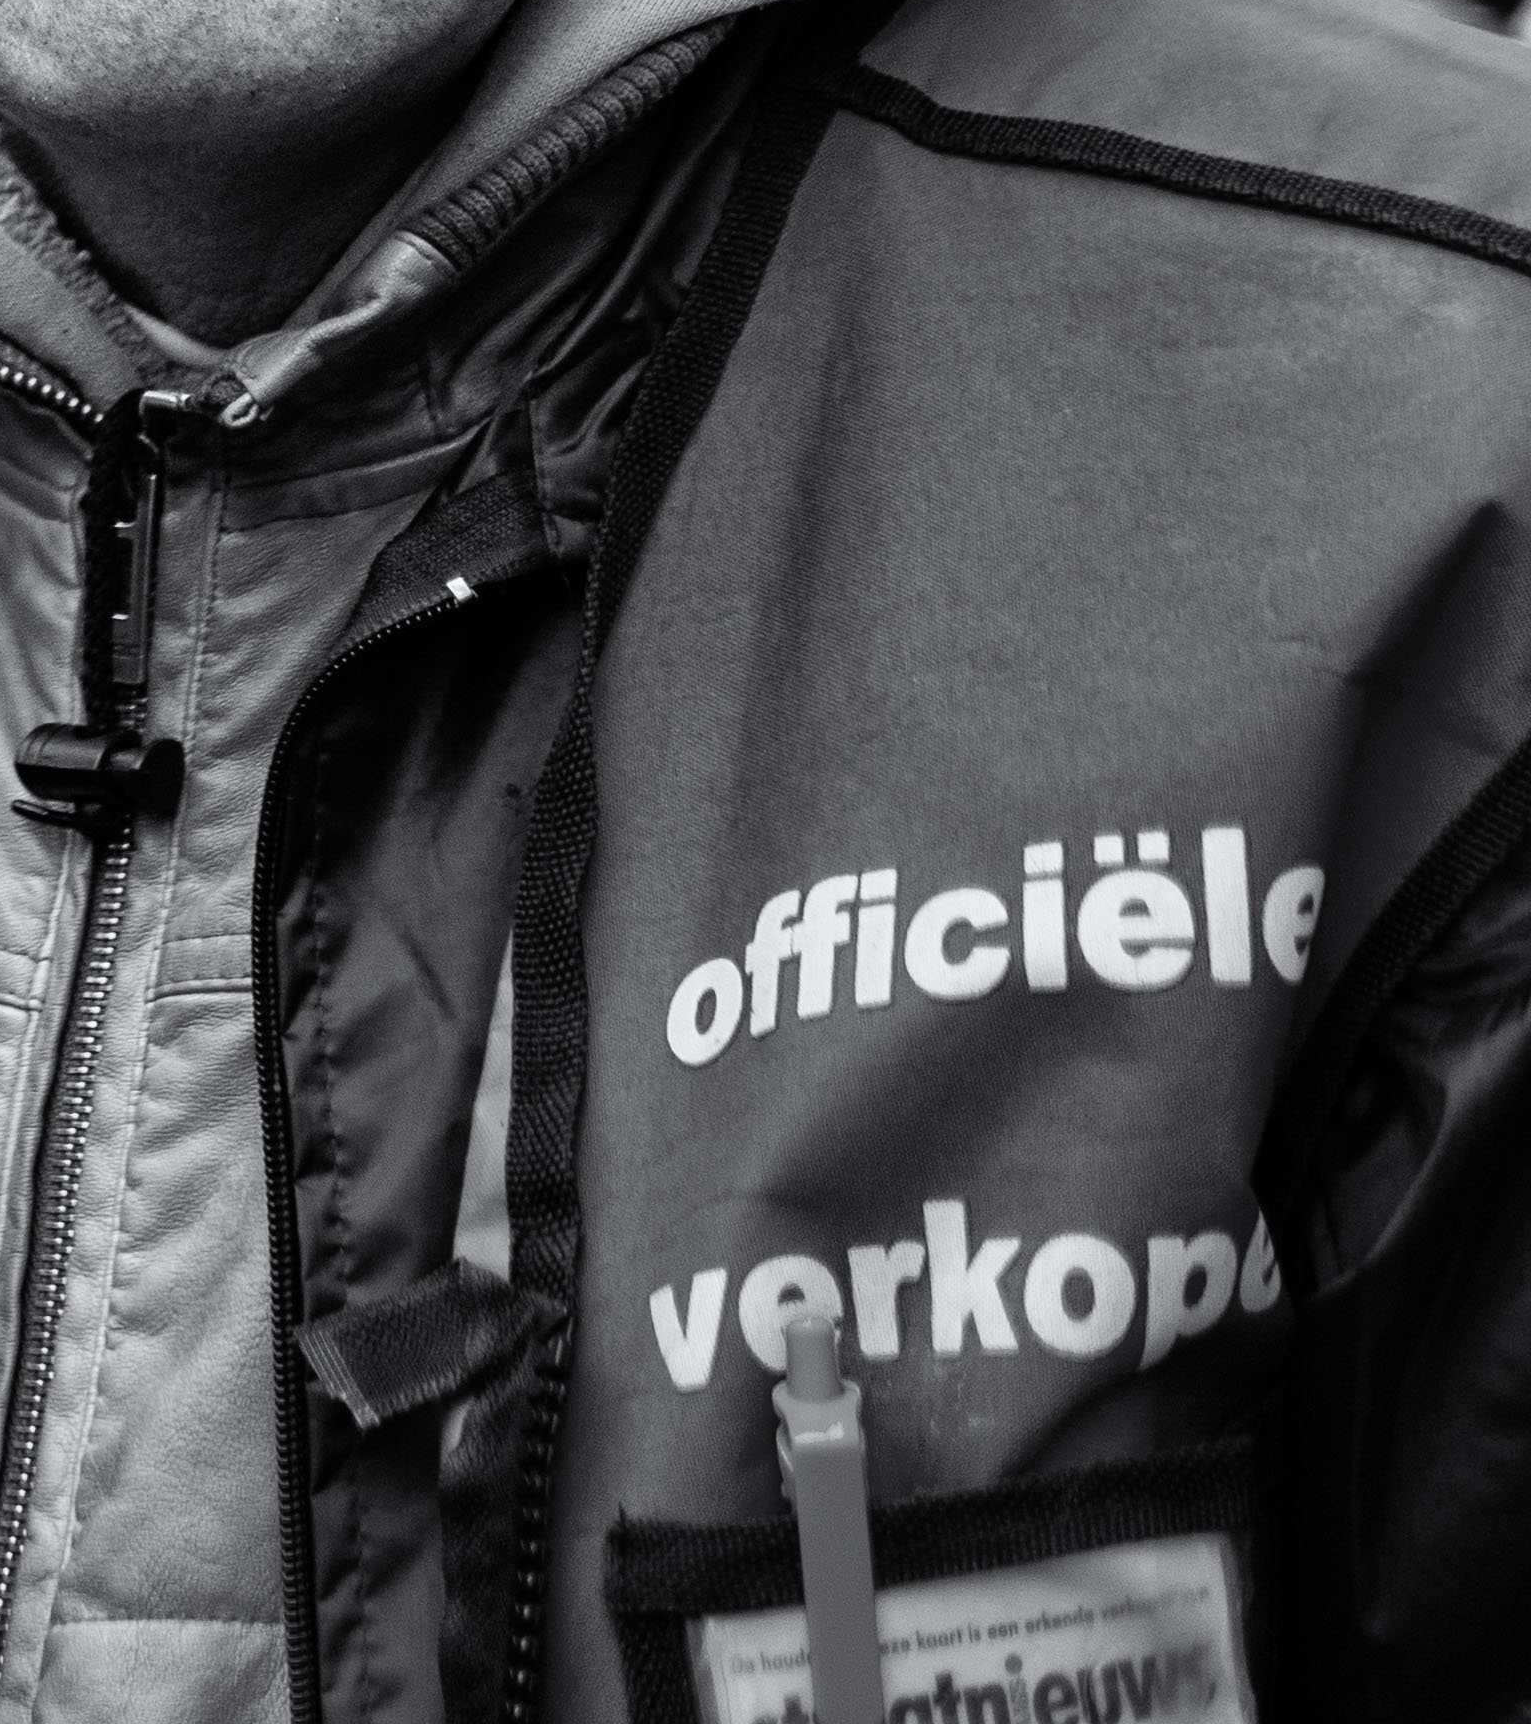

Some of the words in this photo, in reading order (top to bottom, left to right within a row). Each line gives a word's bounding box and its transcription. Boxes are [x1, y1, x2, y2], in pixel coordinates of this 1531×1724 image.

[666, 826, 1325, 1066] officiële
[759, 1647, 811, 1672] houd
[915, 1627, 963, 1649] kaart
[968, 1623, 982, 1643] is
[987, 1621, 1019, 1640] een
